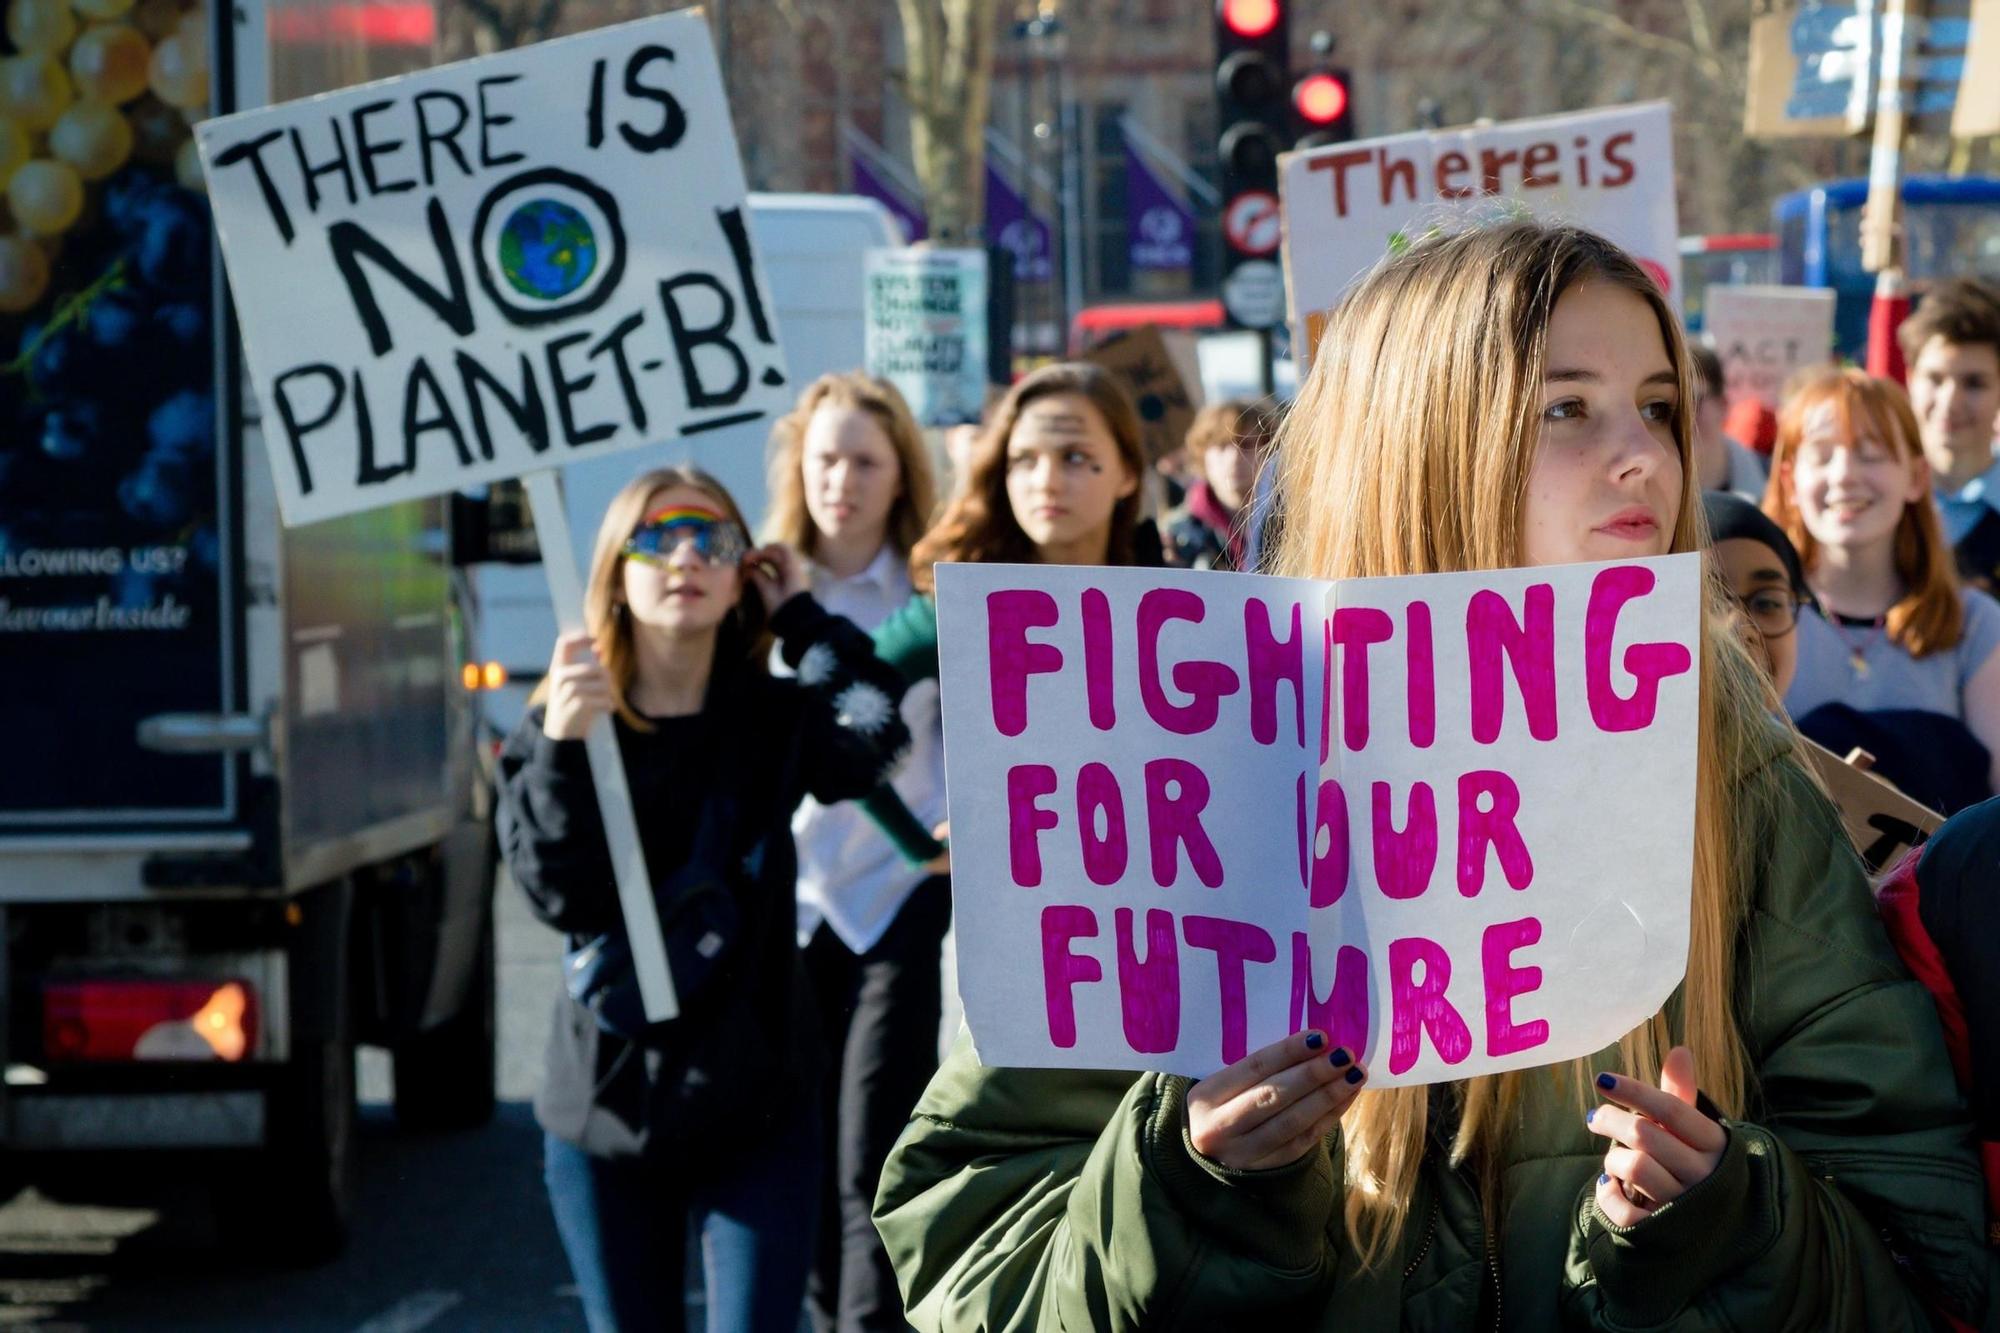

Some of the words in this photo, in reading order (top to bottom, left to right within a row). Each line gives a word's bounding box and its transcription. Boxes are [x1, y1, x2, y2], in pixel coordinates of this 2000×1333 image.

[213, 74, 526, 246] THERE
[586, 45, 688, 153] IS
[1308, 141, 1560, 217] There
[1574, 132, 1636, 188] is
[328, 166, 627, 357] NO
[273, 206, 786, 495] PLANET-B!
[0, 547, 122, 576] LOWING
[130, 545, 188, 574] US?
[986, 565, 1692, 764] FIGHTING
[1006, 758, 1224, 888] FOR
[1295, 770, 1535, 909] OUR
[1040, 904, 1550, 1077] FUTURE
